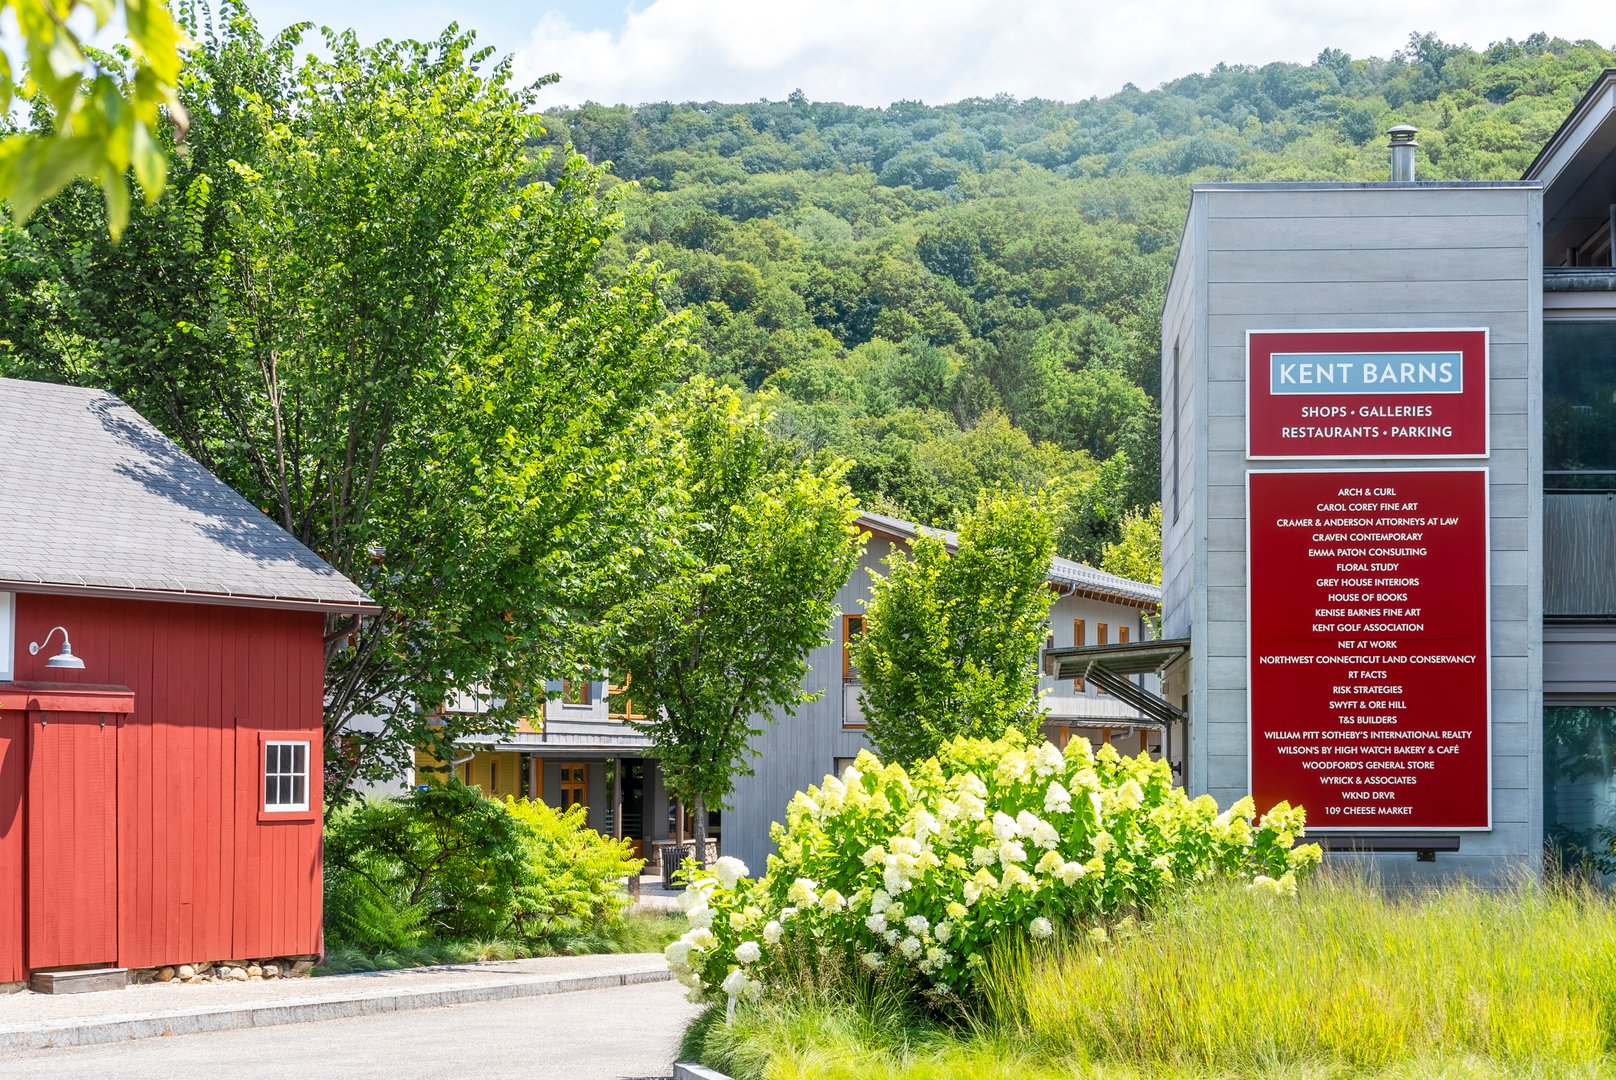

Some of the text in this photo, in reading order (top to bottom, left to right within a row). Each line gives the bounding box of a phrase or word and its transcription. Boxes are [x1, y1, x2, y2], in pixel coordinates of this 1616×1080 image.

[1280, 363, 1453, 384] KENT BARNS
[1301, 406, 1433, 418] SHOPS GALLERIES
[1282, 426, 1453, 438] RESTAURANTS PARKING
[1337, 488, 1397, 496] ARCH & CURL
[1316, 502, 1419, 512] CAROL COREY FINE ART
[1276, 517, 1459, 528] CRAMER & ANDERSON ATTORNEYS AT LAW
[1312, 532, 1424, 542] CRAVEN CONTEMPORARY
[1308, 548, 1428, 557] EMMA PATON CONSULTING
[1336, 562, 1399, 572] FLORAL STUDY
[1316, 578, 1420, 587] GREY HOUSE INTERIORS
[1328, 592, 1408, 602] HOUSE OF BOOKS
[1315, 608, 1422, 617] KENISE BARNES FINE ART
[1312, 623, 1424, 632] KENT GOLF ASSOCIATION
[1337, 640, 1398, 649] NET AT WORK
[1259, 655, 1477, 664] NORTHWEST CONNECTICUT LAND CONSERVANCY
[1348, 670, 1387, 679] RT FACTS
[1332, 685, 1403, 694] RISK STRATEGIES
[1329, 700, 1407, 710] SWYFT & ORE HILL
[1338, 716, 1398, 724] T&S BUILDERS
[1264, 731, 1301, 740] WILLIAM
[1302, 731, 1320, 740] PITT
[1370, 730, 1441, 739] INTERNATIONAL
[1441, 730, 1473, 739] REALTY
[1277, 744, 1460, 755] WILSON'S BY HIGH WATCH BAKERY & CAFÉ
[1301, 760, 1435, 770] WOODFORD'S GENERAL STORE
[1319, 776, 1417, 785] WYRICK & ASSOCIATES
[1341, 791, 1395, 800] WKND DRVR
[1325, 806, 1413, 815] 109 CHEESE MARKET
